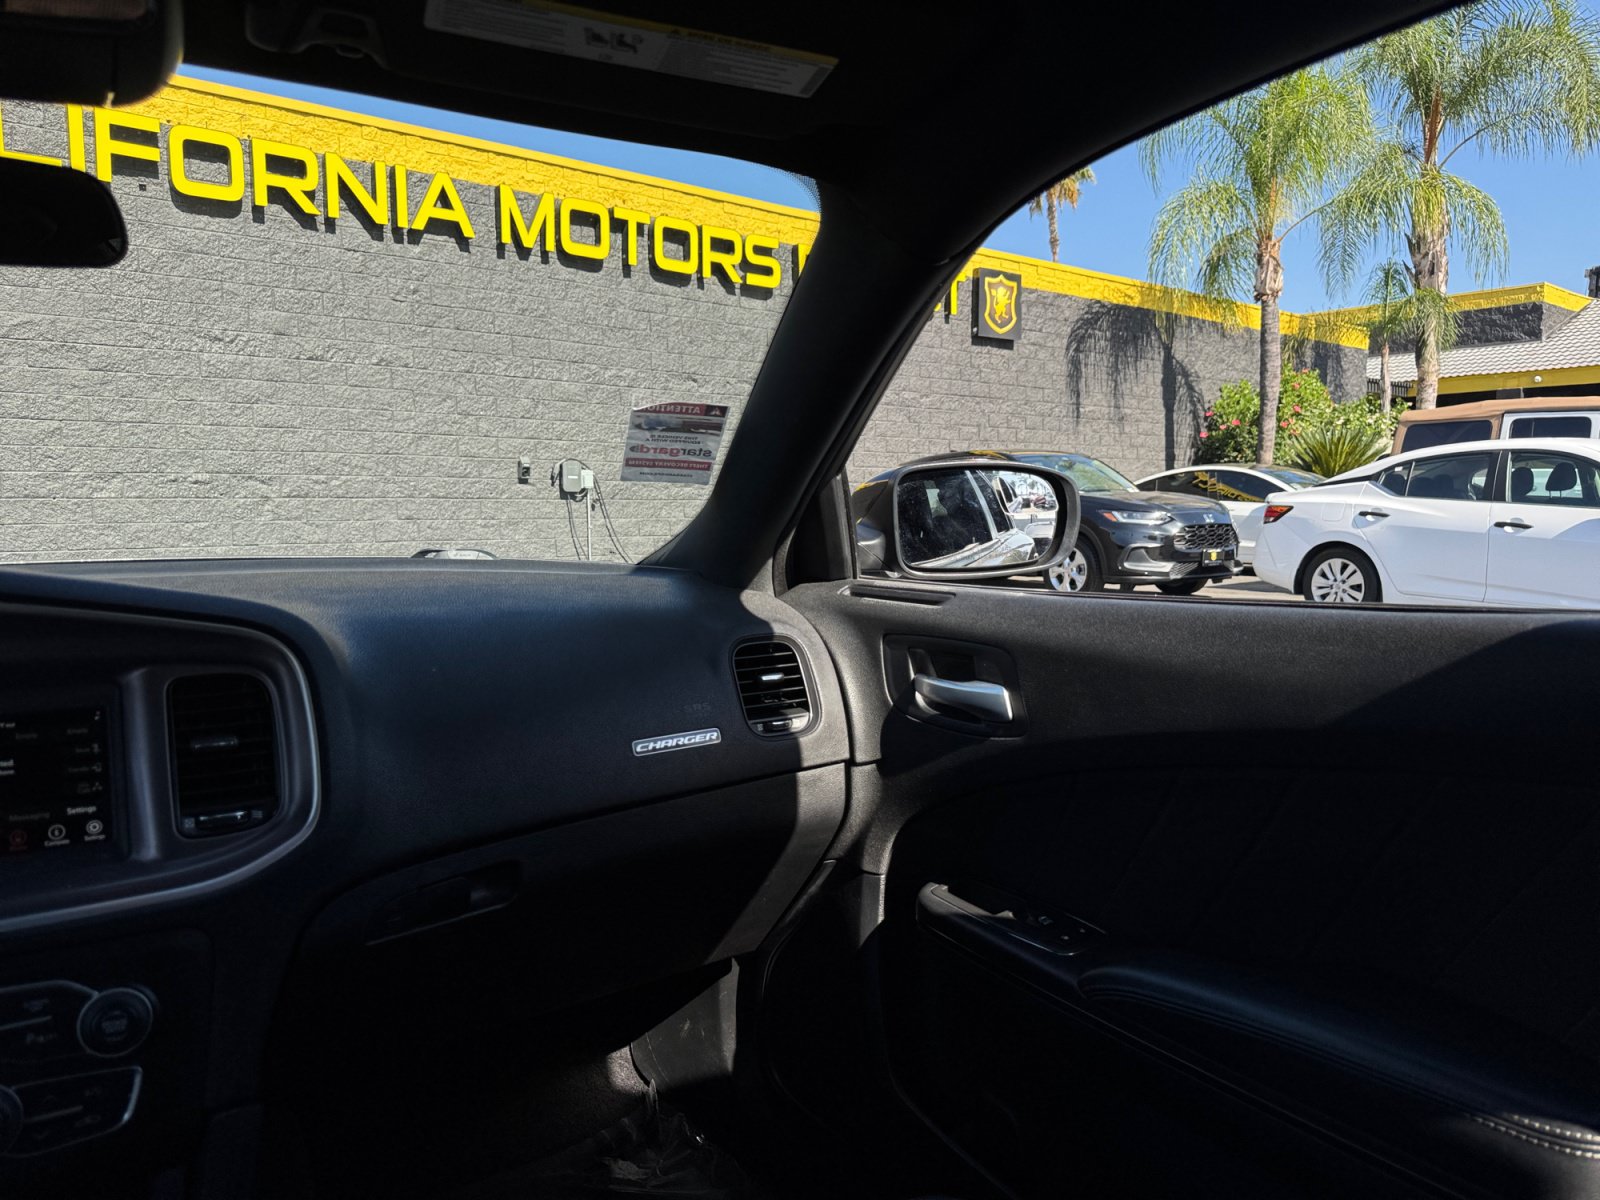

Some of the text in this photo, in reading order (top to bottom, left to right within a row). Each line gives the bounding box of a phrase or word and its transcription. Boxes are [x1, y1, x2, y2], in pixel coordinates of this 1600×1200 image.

[500, 184, 782, 289] MOTORS
[636, 731, 719, 752] CHARGER
[67, 805, 97, 816] Settings
